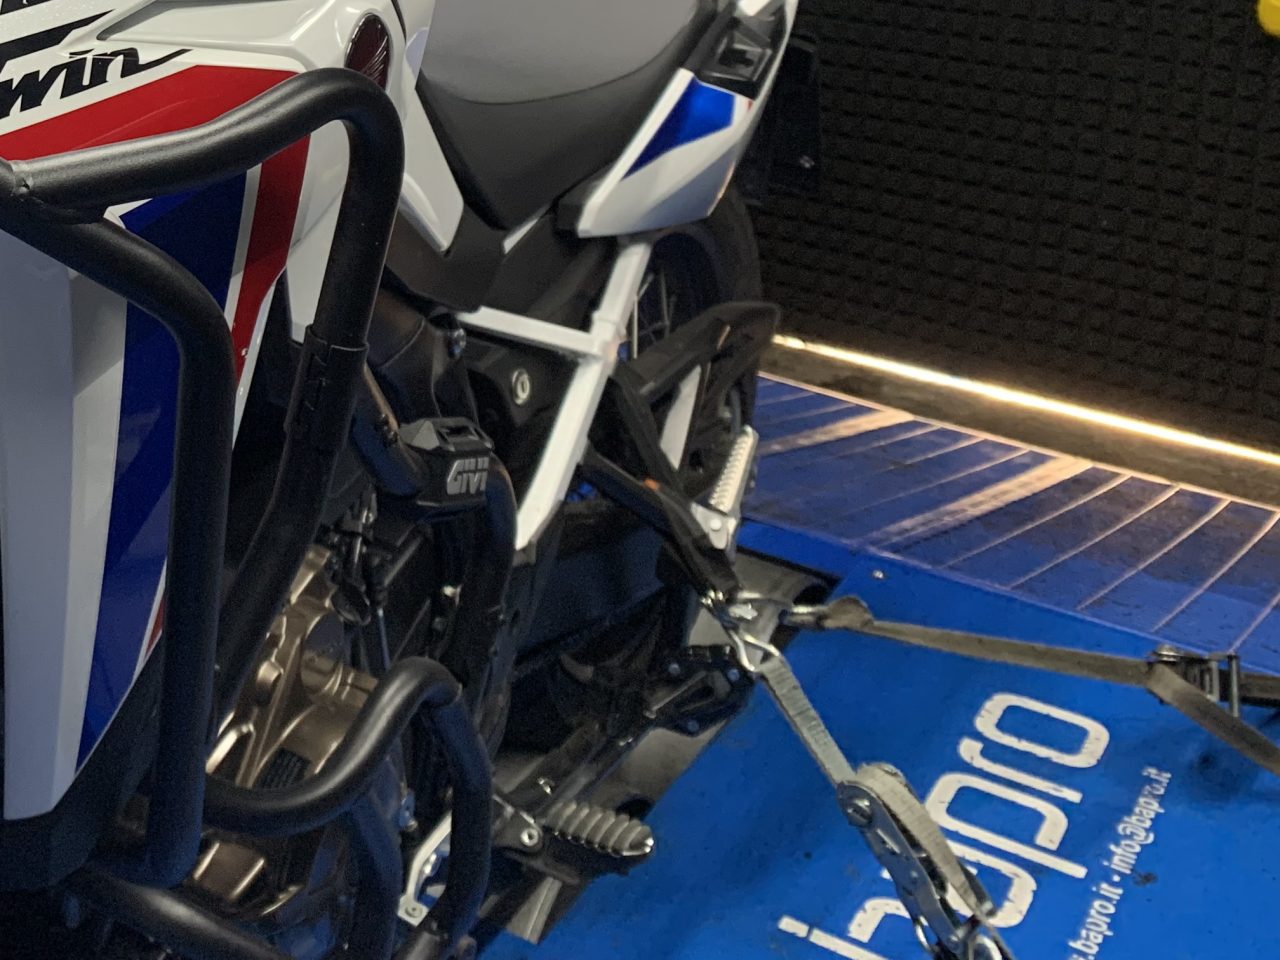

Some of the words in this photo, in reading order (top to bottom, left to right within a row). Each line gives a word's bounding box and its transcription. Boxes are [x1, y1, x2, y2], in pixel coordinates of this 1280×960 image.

[446, 456, 490, 496] GIVI
[1067, 882, 1124, 960] .bapro.it
[1102, 766, 1172, 874] info@bapro.it
